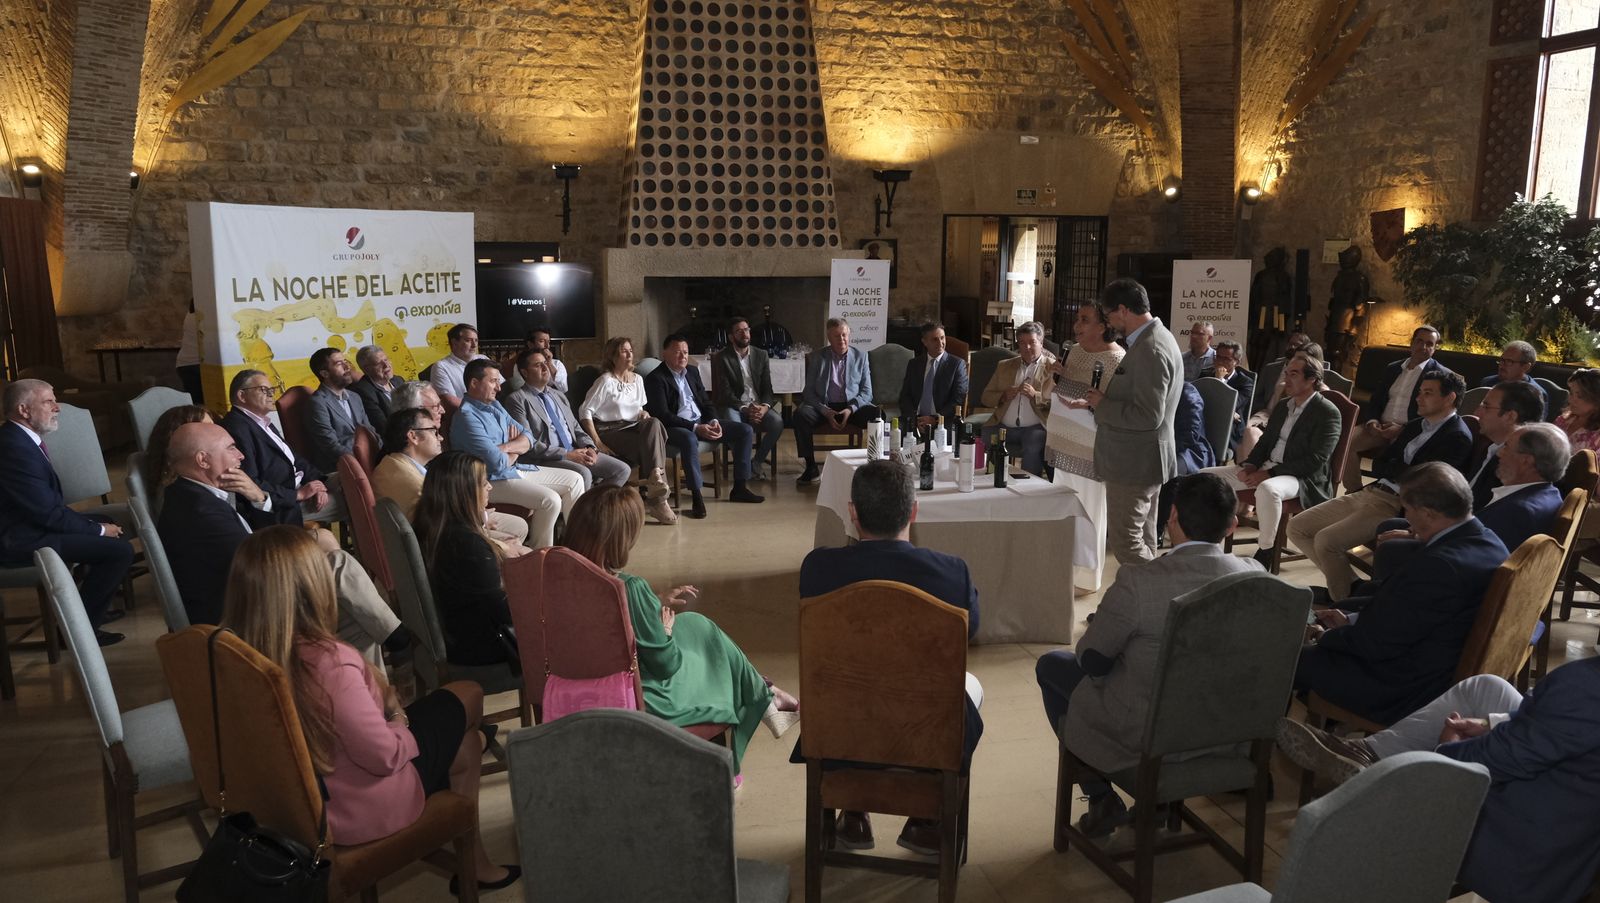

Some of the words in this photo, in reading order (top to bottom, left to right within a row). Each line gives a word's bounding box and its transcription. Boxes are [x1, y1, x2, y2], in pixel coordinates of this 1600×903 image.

[231, 277, 265, 303] LA
[272, 275, 349, 301] NOCHE
[355, 273, 394, 298] DEL
[400, 271, 462, 295] ACEITE
[838, 287, 850, 296] LA
[852, 287, 881, 296] NOCHE
[1182, 290, 1196, 298] LA
[1200, 290, 1239, 298] NOCHE
[836, 298, 850, 306] DEL
[852, 297, 882, 306] ACEITE
[1179, 301, 1197, 309] DEL
[1201, 301, 1240, 309] ACEITE
[410, 299, 462, 317] expoliva
